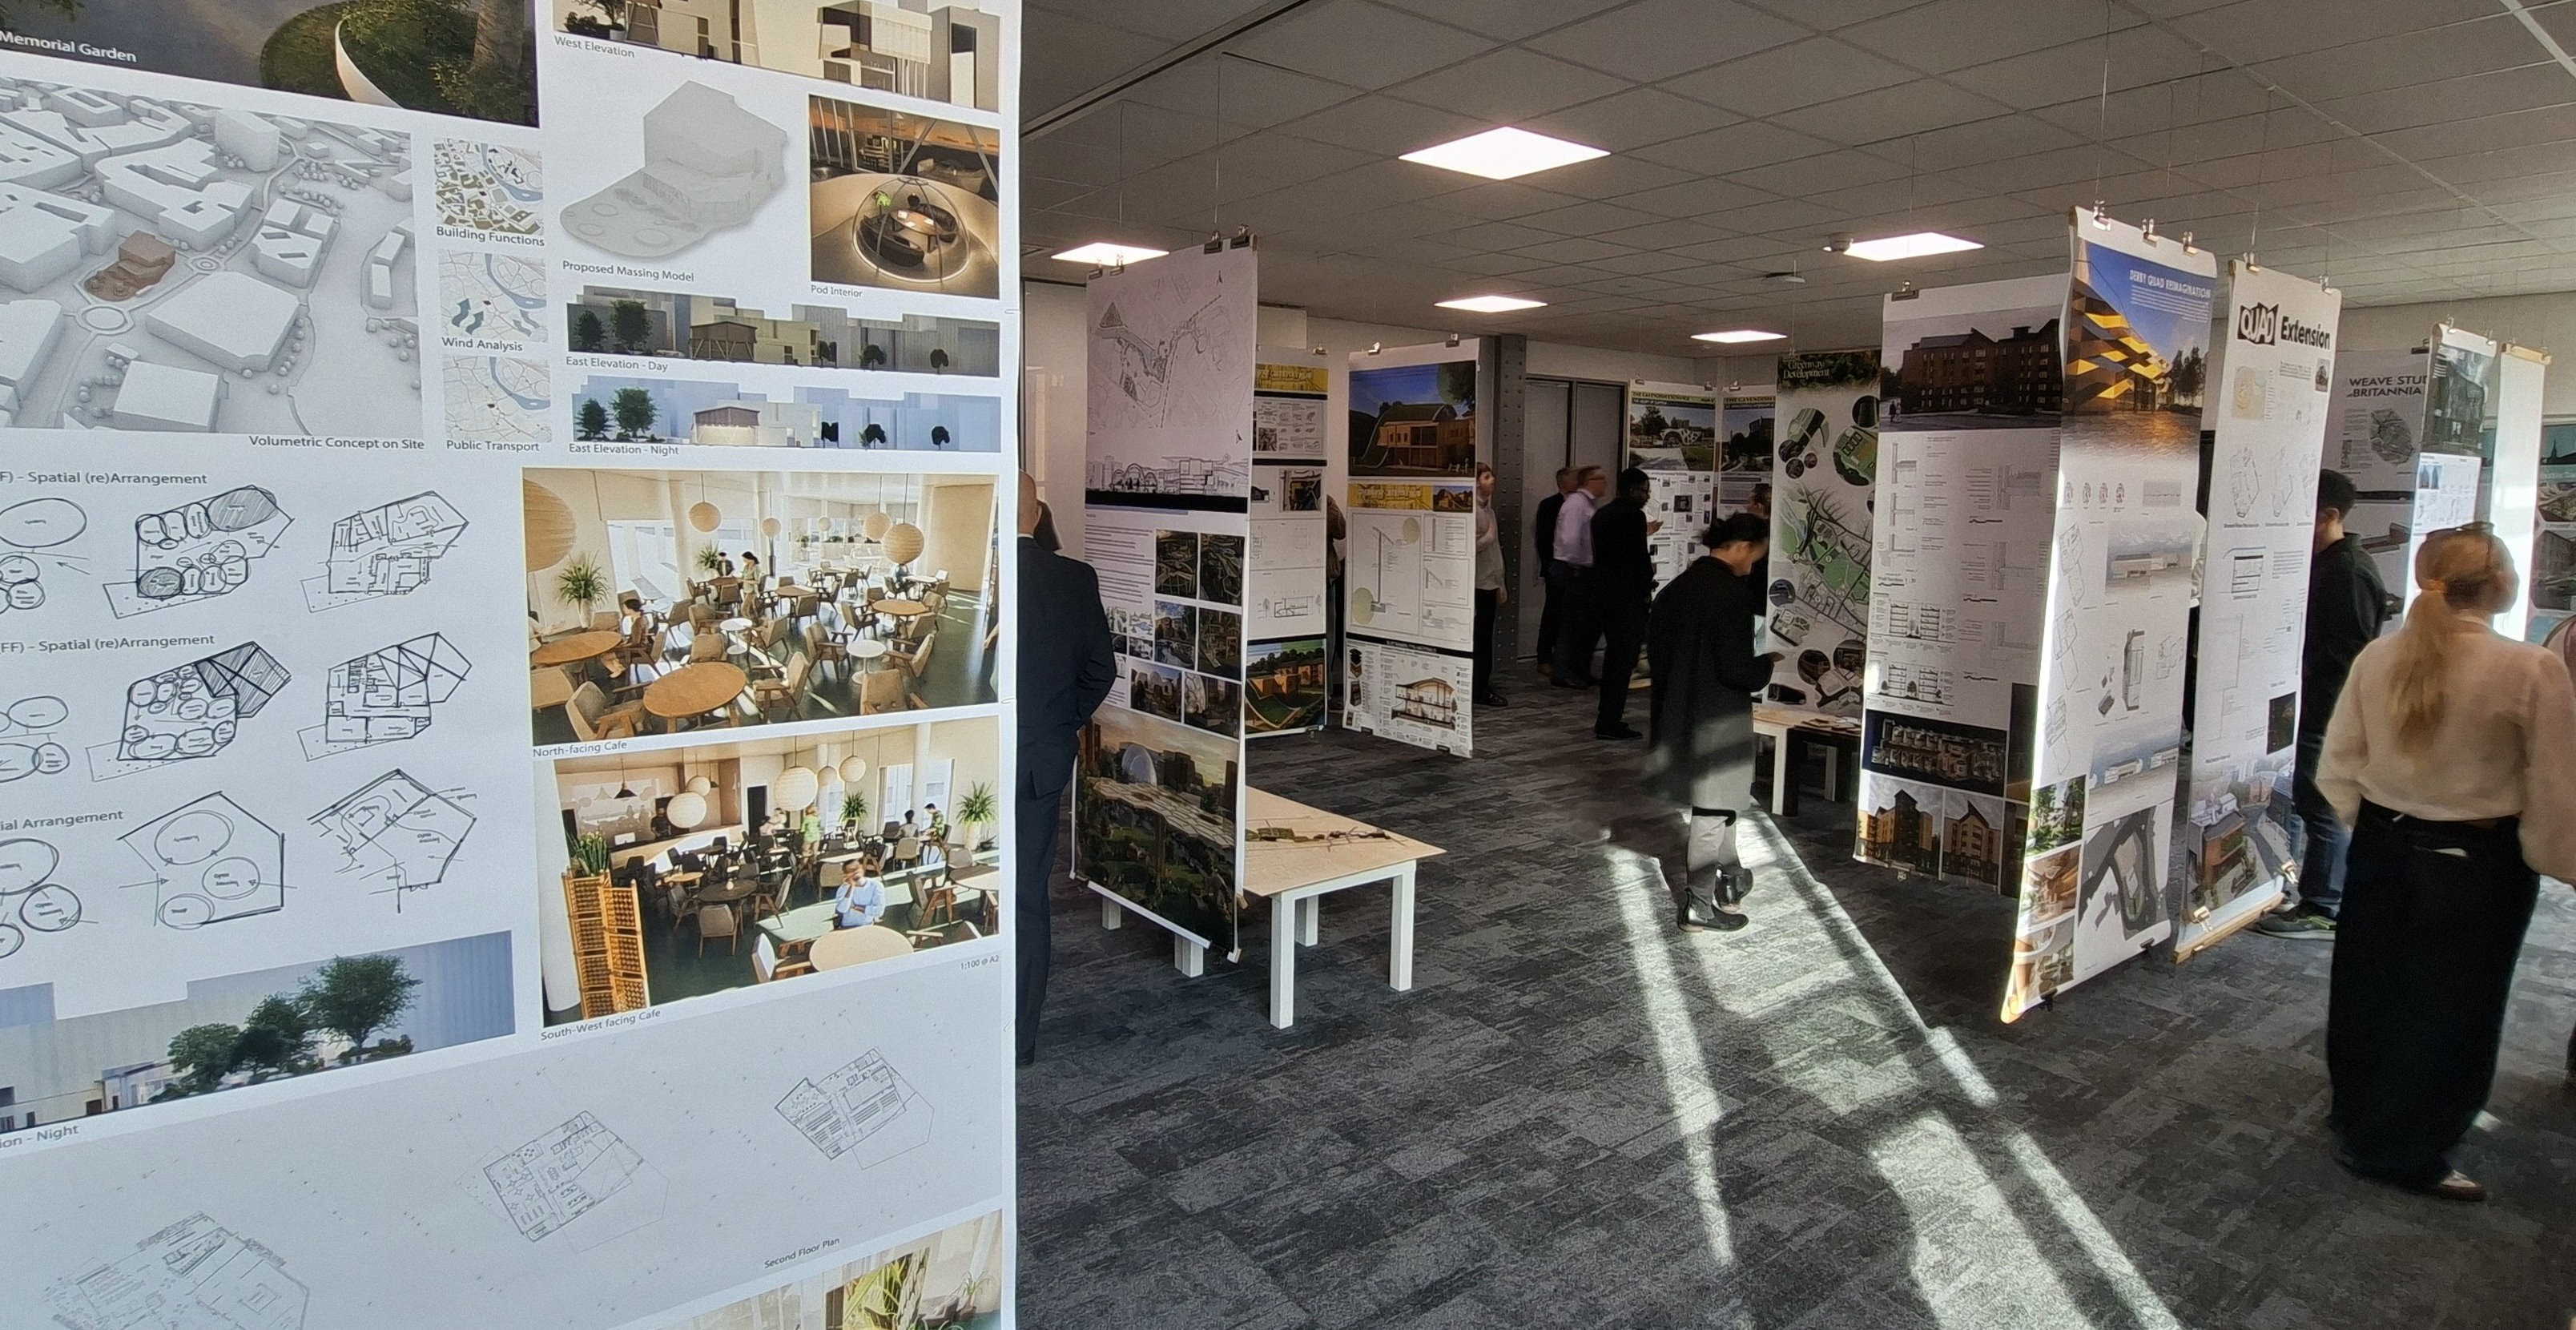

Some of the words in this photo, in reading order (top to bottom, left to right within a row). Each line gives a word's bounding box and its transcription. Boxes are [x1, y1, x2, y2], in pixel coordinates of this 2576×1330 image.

[0, 30, 76, 54] Memorial
[78, 42, 138, 62] Garden
[554, 34, 582, 50] West
[585, 40, 635, 58] Elevation
[436, 226, 486, 243] Building
[489, 232, 545, 247] Functions
[562, 260, 614, 276] Proposed
[617, 265, 660, 281] Massing
[662, 270, 694, 282] Model
[811, 284, 829, 295] Pod
[831, 286, 863, 298] Interior
[2240, 307, 2276, 344] QUAD
[2280, 316, 2331, 350] Extension
[441, 337, 473, 349] Wind
[477, 340, 523, 353] Analysis
[566, 356, 588, 366] East
[590, 357, 639, 369] Elevation
[648, 361, 668, 373] Day
[2349, 376, 2393, 387] WEAVE
[2353, 386, 2422, 398] BRITANNIA
[248, 435, 323, 448] Volumetric
[325, 437, 380, 449] Concept
[382, 440, 399, 449] on
[401, 438, 425, 449] Site
[446, 439, 482, 450] Public
[485, 441, 540, 453] Transport
[569, 443, 591, 453] East
[594, 444, 641, 454] Elevation
[650, 445, 679, 456] Night
[27, 471, 81, 485] Spatial
[85, 471, 208, 486] (re)Arrangement
[38, 639, 91, 654] Spatial
[95, 635, 215, 651] (re)Arrangement
[533, 743, 602, 758] North-facing
[604, 740, 627, 751] Cafe
[22, 810, 124, 829] Arrangement
[960, 959, 980, 970] 1:100
[989, 954, 1000, 964] A2
[540, 1021, 602, 1042] South-West
[605, 1014, 636, 1028] facing
[638, 1008, 662, 1021] Cafe
[36, 1125, 80, 1143] Night
[763, 1251, 797, 1269] Second
[798, 1243, 821, 1257] Floor
[822, 1237, 840, 1249] Plan
